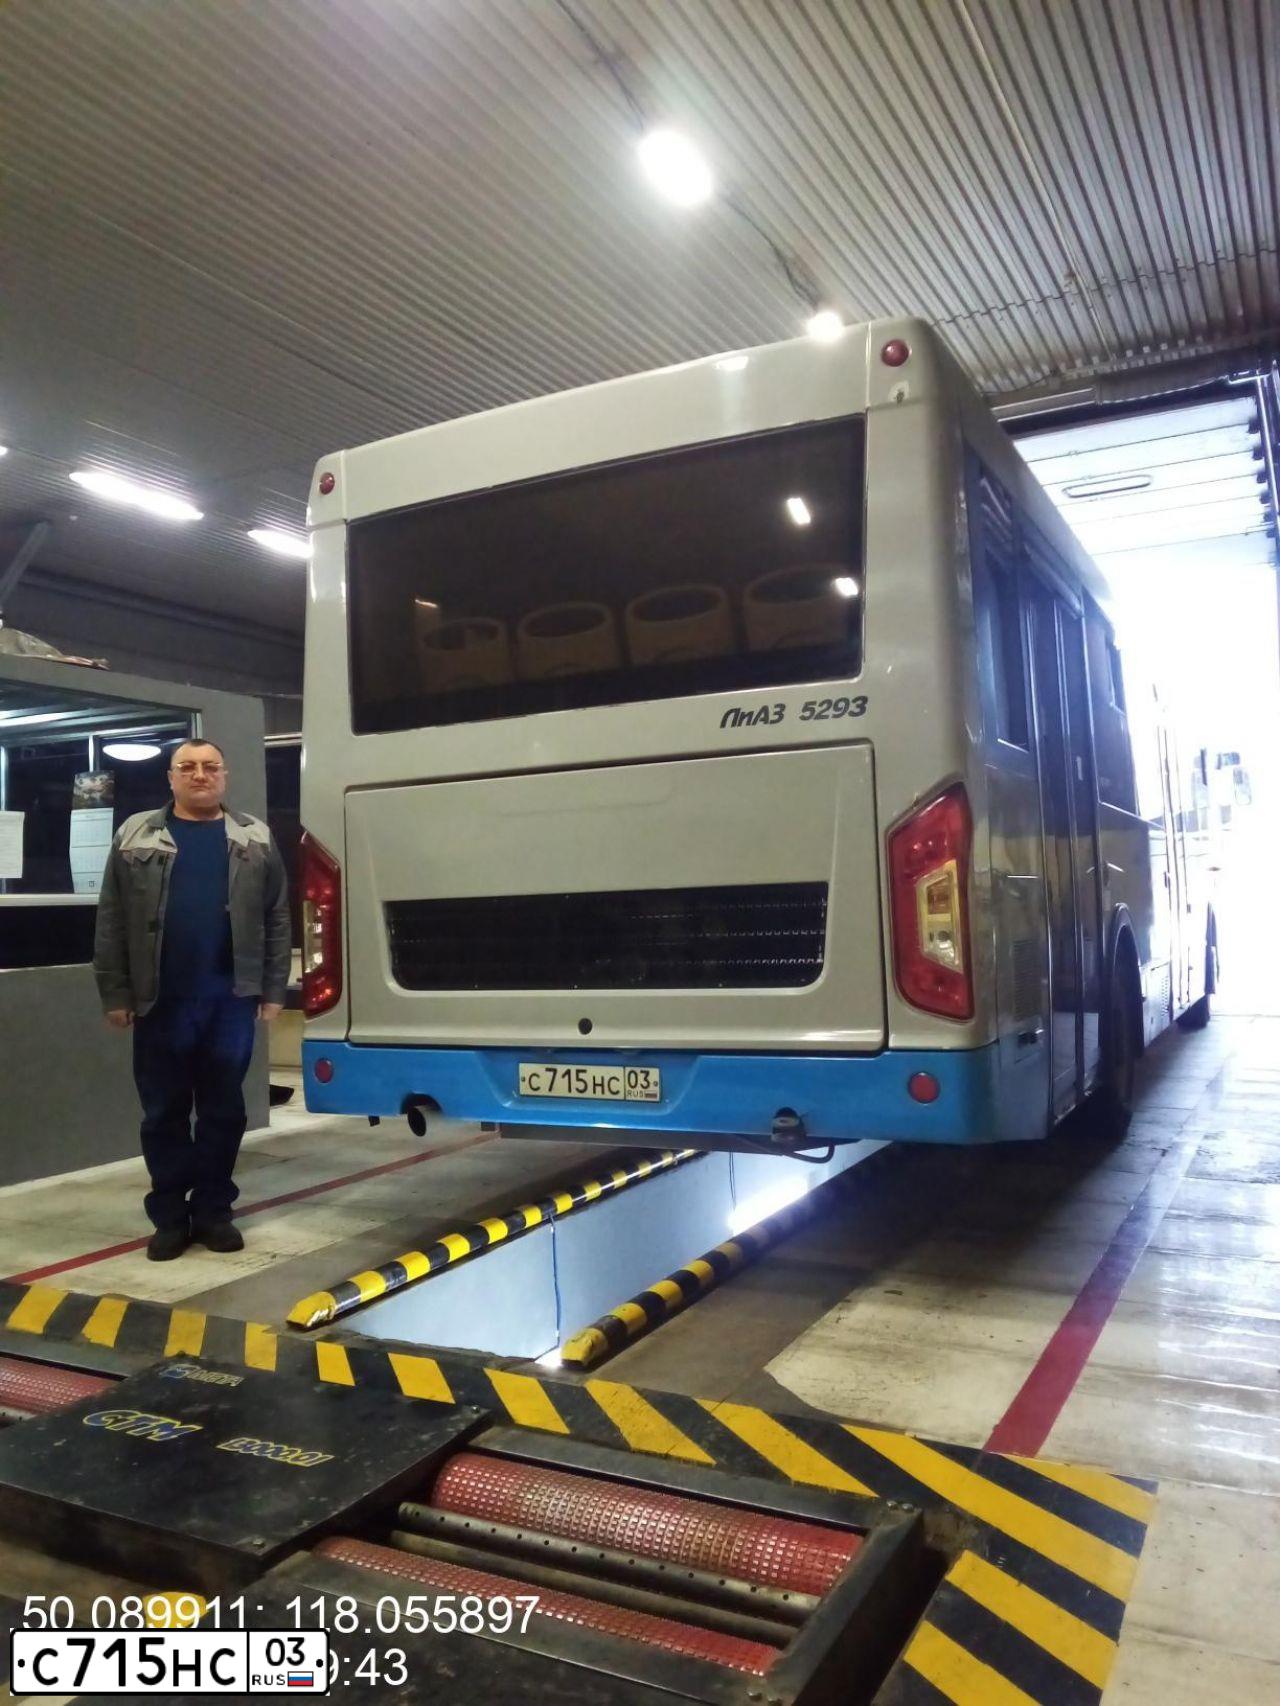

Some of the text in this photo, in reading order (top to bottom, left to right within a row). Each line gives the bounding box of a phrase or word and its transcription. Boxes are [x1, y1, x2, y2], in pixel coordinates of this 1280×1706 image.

[799, 696, 868, 721] 5293
[528, 1067, 650, 1095] С715НС 03
[627, 1090, 644, 1098] RUS
